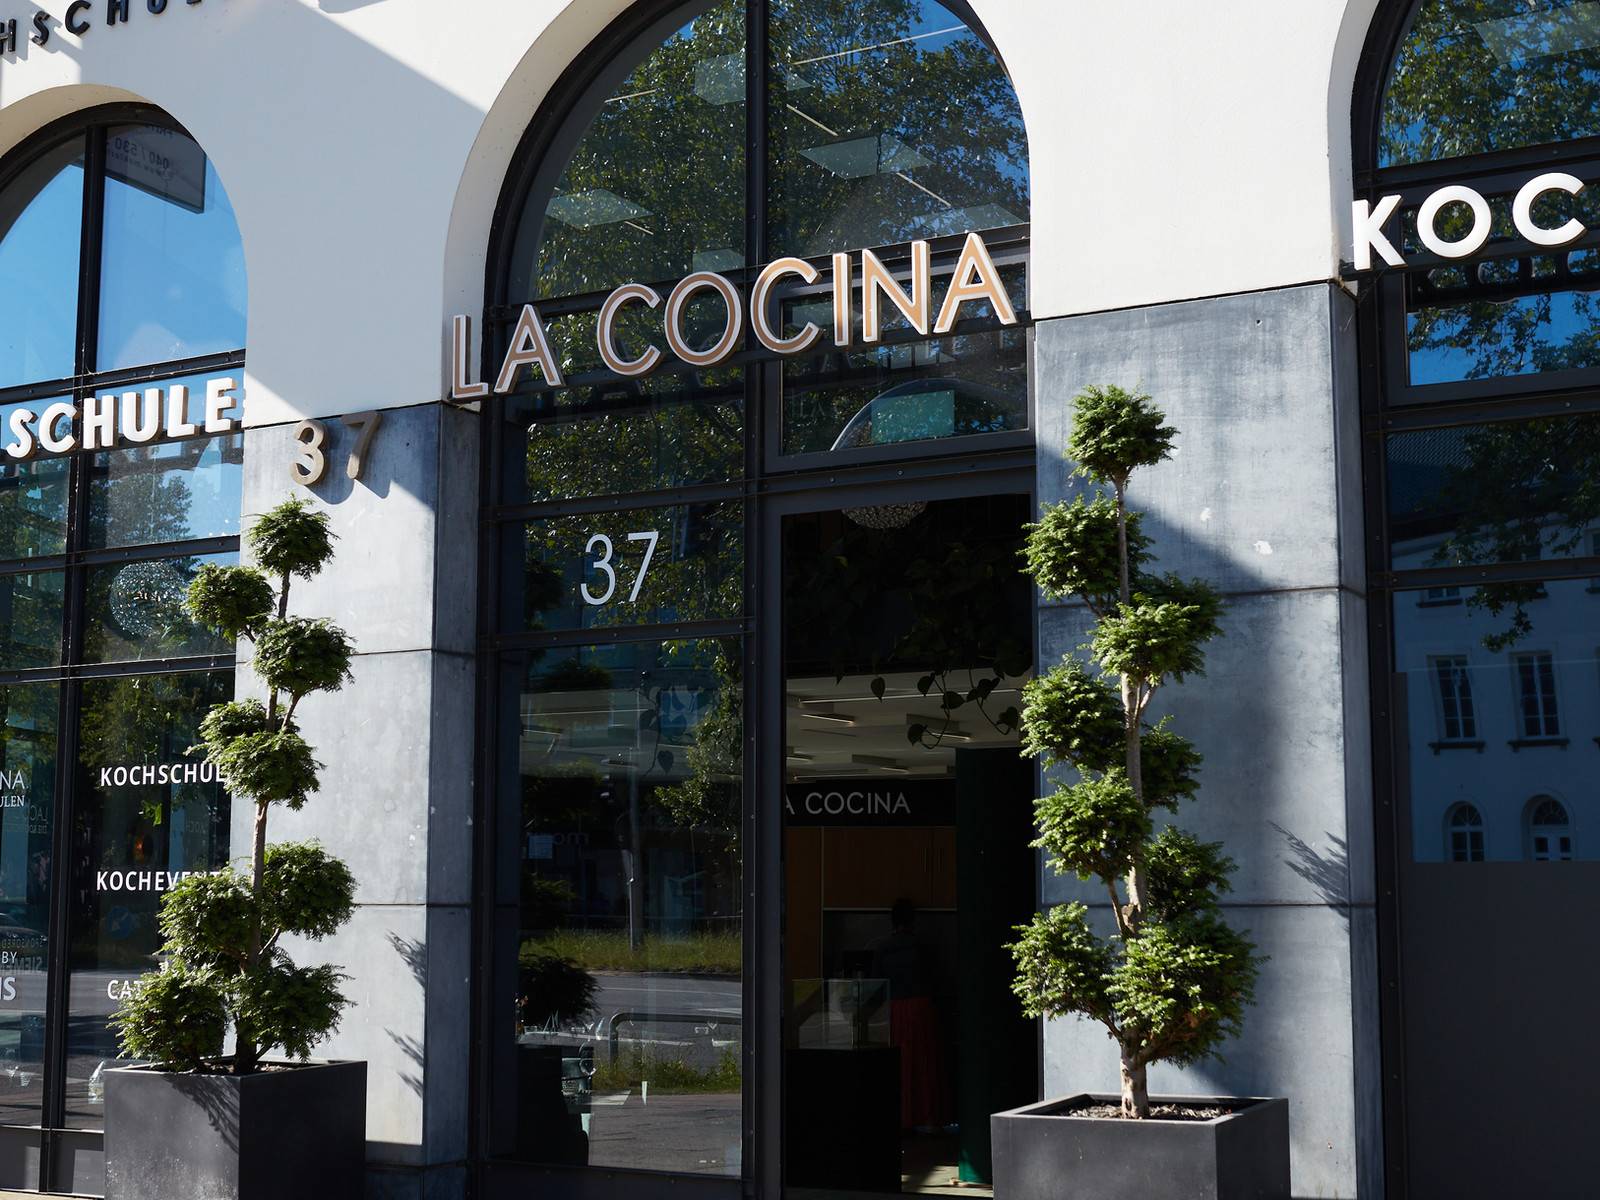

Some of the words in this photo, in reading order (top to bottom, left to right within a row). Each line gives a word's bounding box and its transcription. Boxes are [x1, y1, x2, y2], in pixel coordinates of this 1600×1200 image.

[0, 0, 200, 55] HSCH
[1351, 172, 1587, 271] KOC
[452, 303, 566, 399] LA
[597, 232, 1018, 376] COCINA
[5, 376, 239, 459] SCHULE
[290, 410, 381, 486] 37
[579, 530, 660, 606] 37
[804, 791, 912, 815] COCINA
